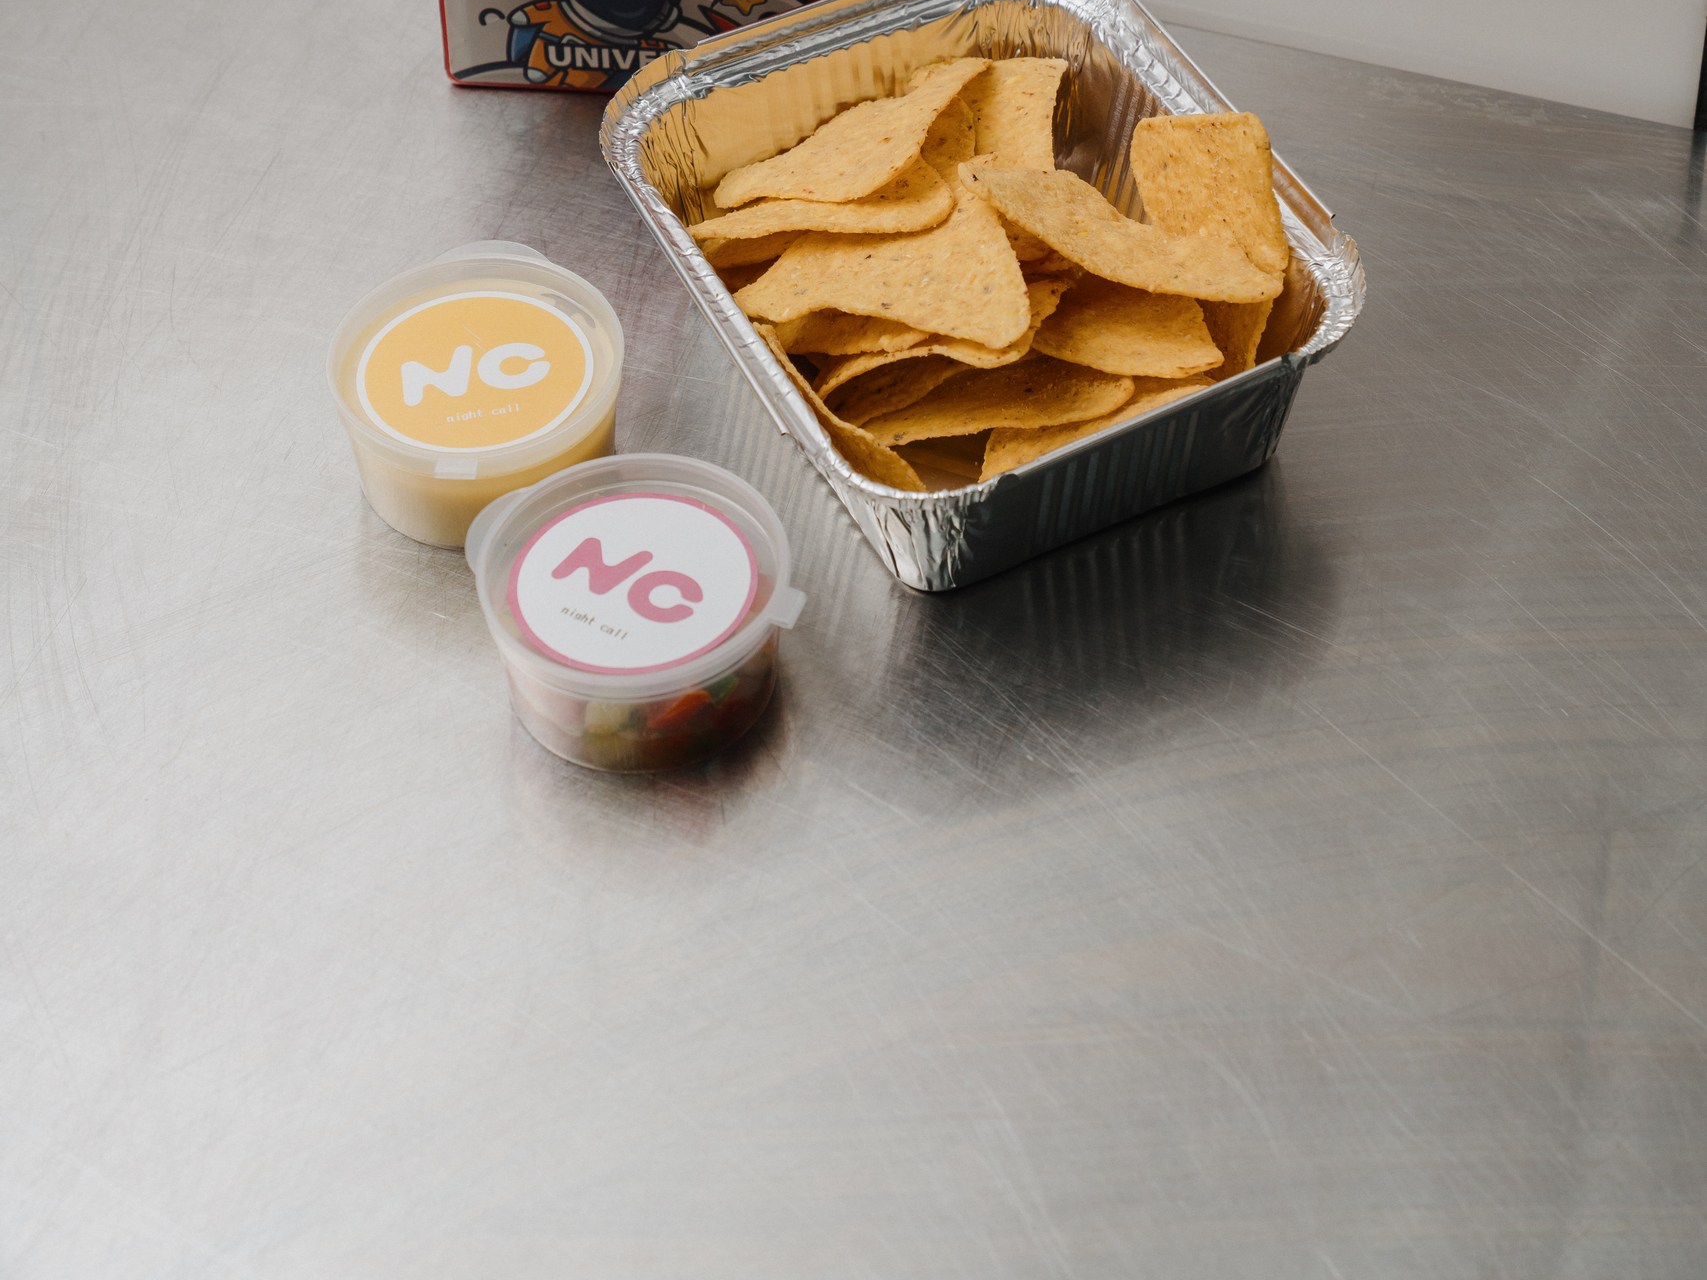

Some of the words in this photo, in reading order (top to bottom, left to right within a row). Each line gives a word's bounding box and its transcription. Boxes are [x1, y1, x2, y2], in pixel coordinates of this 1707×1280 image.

[548, 45, 667, 70] UNIVE
[400, 342, 551, 407] NC
[446, 409, 484, 423] night
[491, 403, 519, 416] call
[551, 537, 704, 624] NC
[560, 606, 596, 626] night
[600, 624, 628, 640] call
